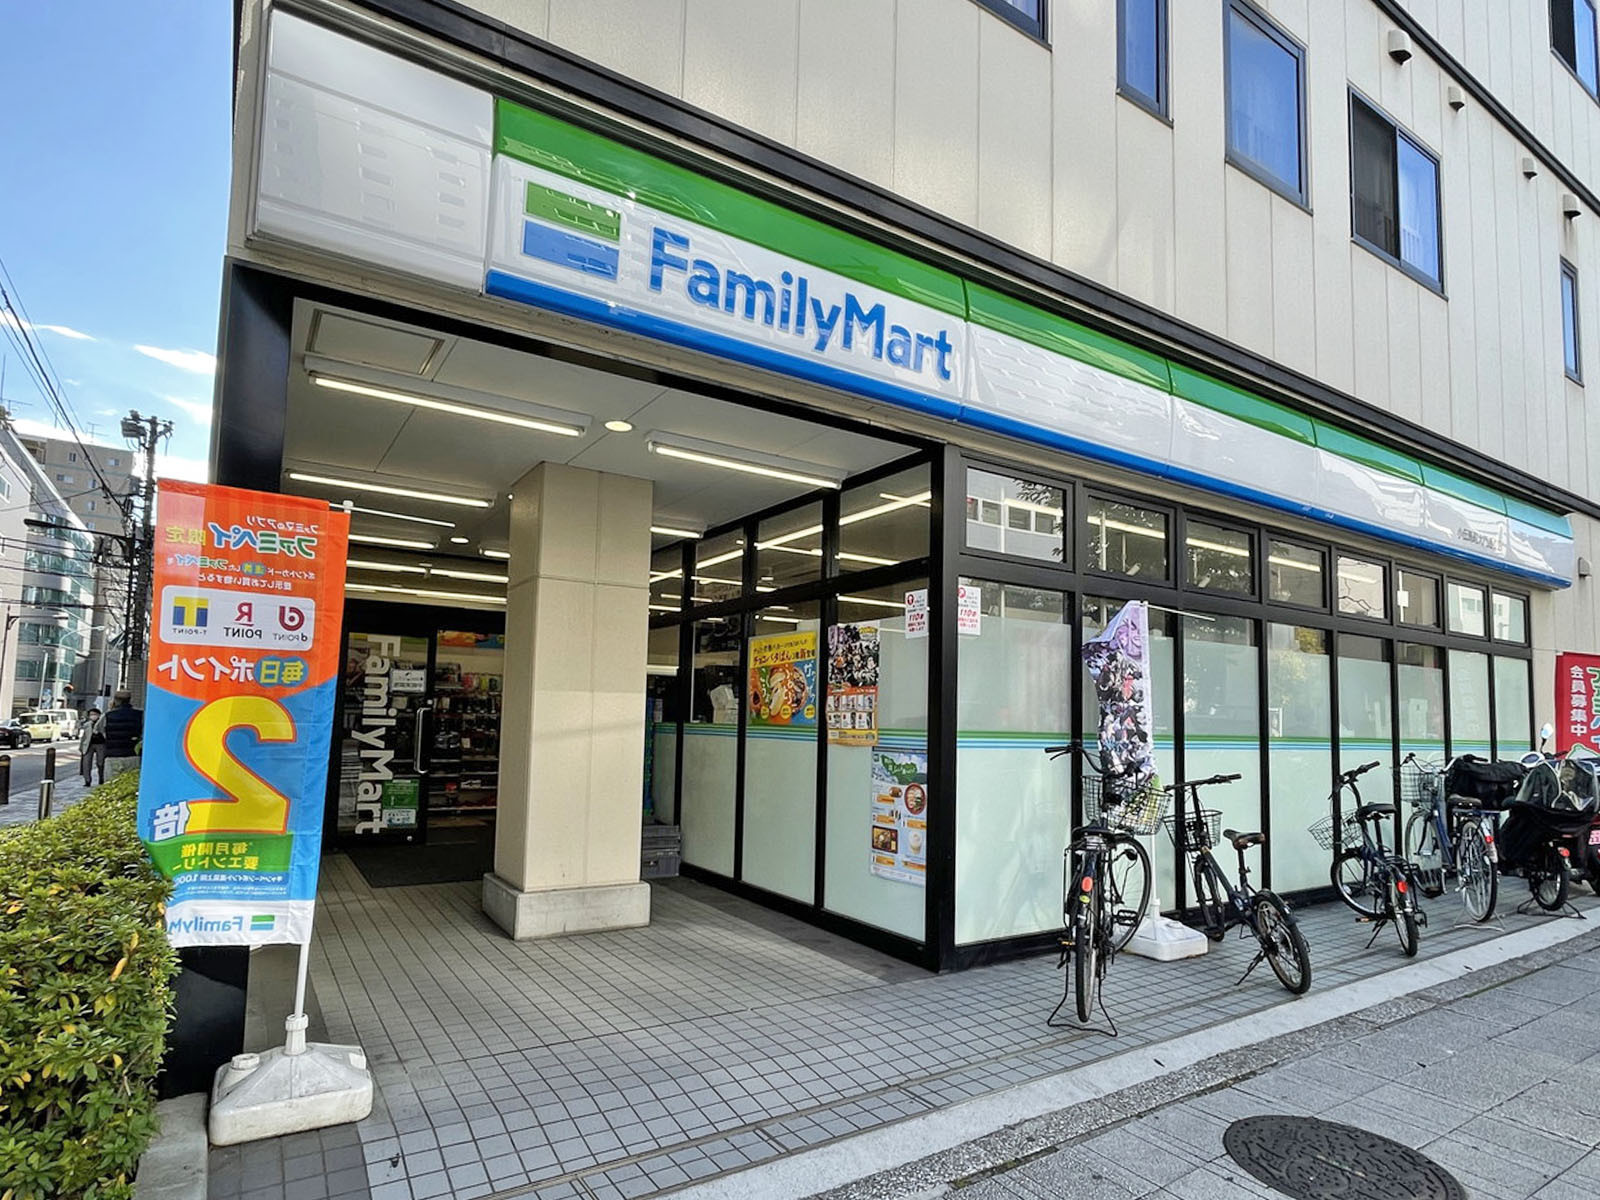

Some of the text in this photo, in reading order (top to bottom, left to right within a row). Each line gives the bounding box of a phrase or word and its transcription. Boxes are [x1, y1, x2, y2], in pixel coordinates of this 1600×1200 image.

[649, 226, 953, 381] FamilyMart
[351, 635, 401, 835] FamilyMart
[1570, 665, 1587, 736] 会員募集中
